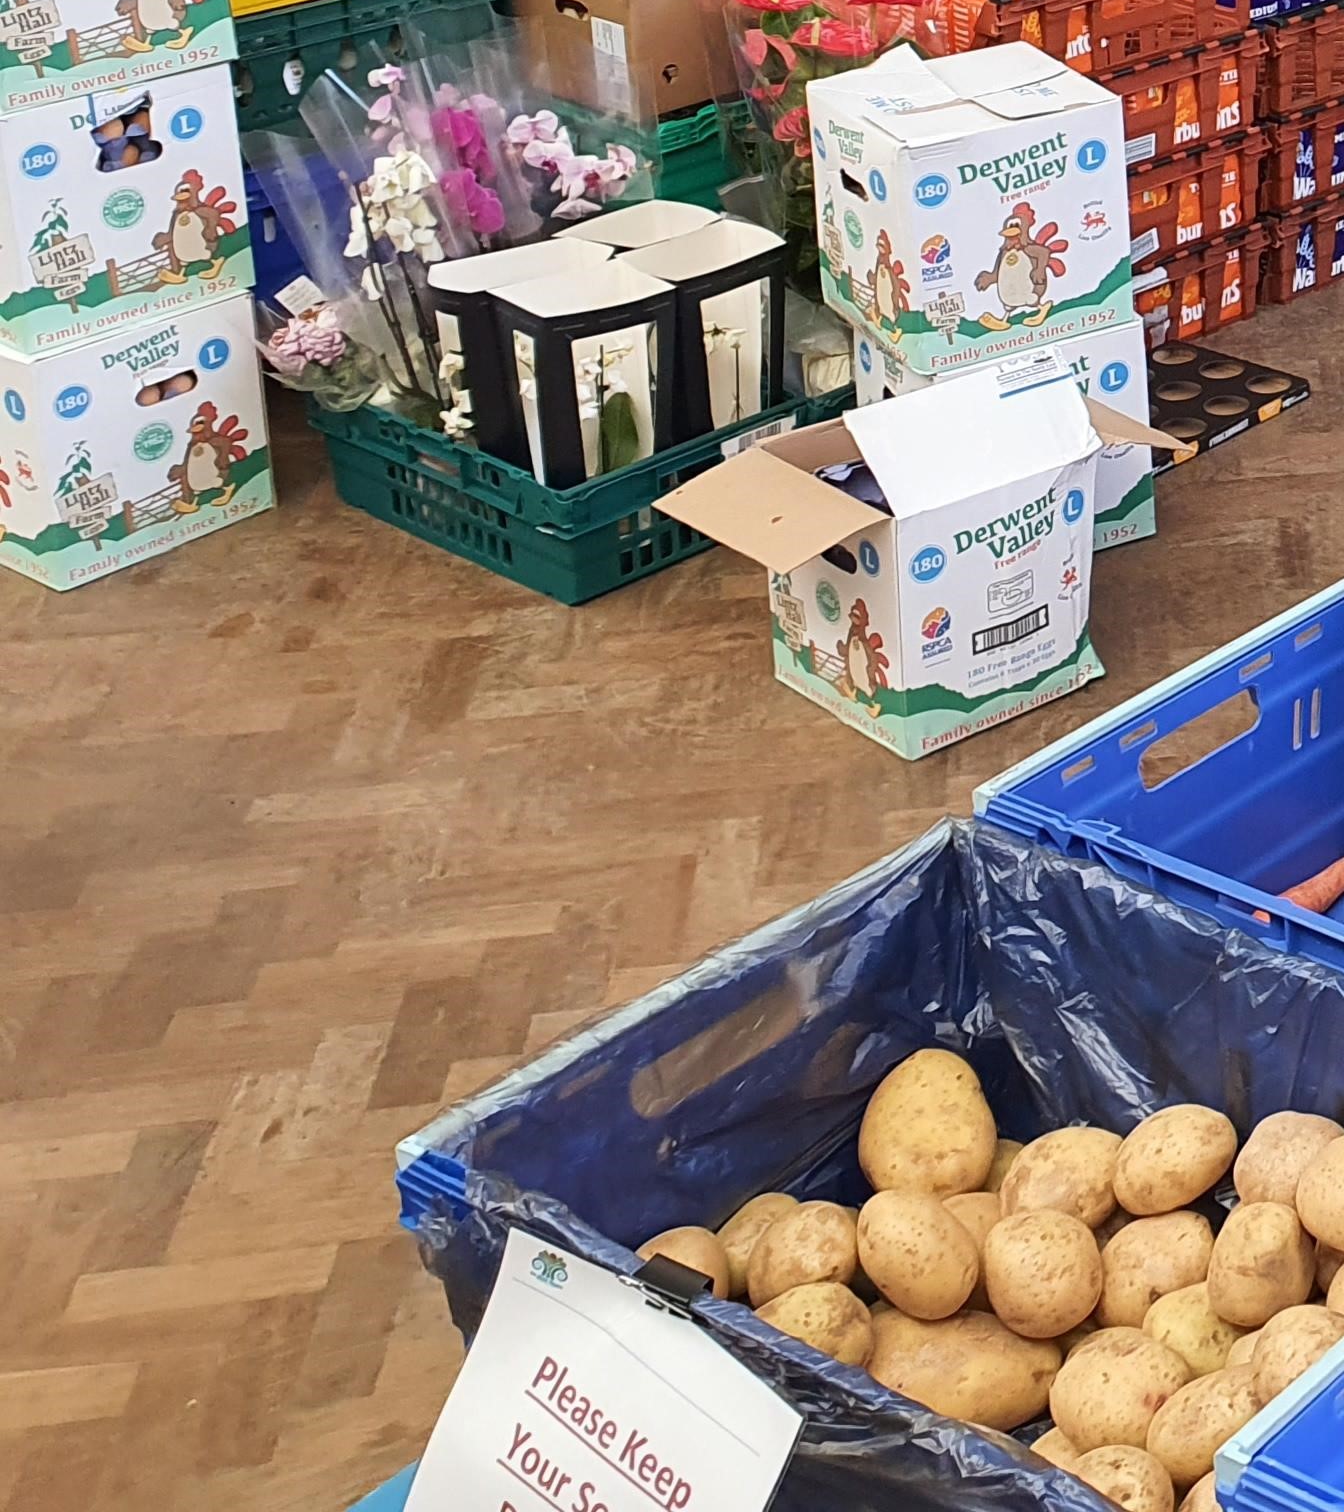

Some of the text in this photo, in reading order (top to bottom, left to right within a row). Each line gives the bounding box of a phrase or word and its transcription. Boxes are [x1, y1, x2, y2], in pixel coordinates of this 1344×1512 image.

[1250, 2, 1278, 19] EDIUM
[18, 13, 54, 35] Hall
[14, 36, 47, 47] Farm
[8, 45, 220, 108] Family owned since 1952
[179, 114, 196, 135] L
[828, 119, 865, 145] Derwent
[838, 138, 864, 161] Valley
[957, 131, 1068, 186] Derwent
[1086, 146, 1100, 165] L
[23, 152, 56, 171] 180
[992, 153, 1068, 194] Valley
[874, 178, 884, 196] L
[916, 180, 948, 199] 180
[1000, 182, 1051, 205] Free range
[54, 249, 87, 271] Hall
[921, 265, 952, 276] RSPCA
[50, 272, 81, 285] Farm
[36, 322, 91, 346] Family
[96, 303, 149, 328] owned
[153, 290, 193, 310] since
[199, 276, 238, 297] 1952
[101, 325, 179, 371] Derwent
[931, 308, 1116, 368] Family owned since 1952
[126, 340, 181, 372] Valley
[208, 346, 223, 365] L
[1109, 368, 1121, 387] L
[11, 395, 22, 415] L
[57, 392, 88, 413] 180
[1067, 493, 1078, 517] L
[953, 487, 1057, 555] Derwent
[69, 497, 259, 582] Family owned since 1952
[986, 509, 1055, 559] Valley
[1103, 525, 1137, 544] 1952
[864, 546, 876, 568] L
[912, 555, 942, 574] 180
[995, 539, 1041, 569] Free range
[922, 638, 952, 653] RSPCA
[967, 639, 1056, 680] 180 Free Range Eggs
[921, 685, 1063, 752] Family owned since
[531, 1356, 692, 1510] Please Keep
[506, 1422, 572, 1499] Your
